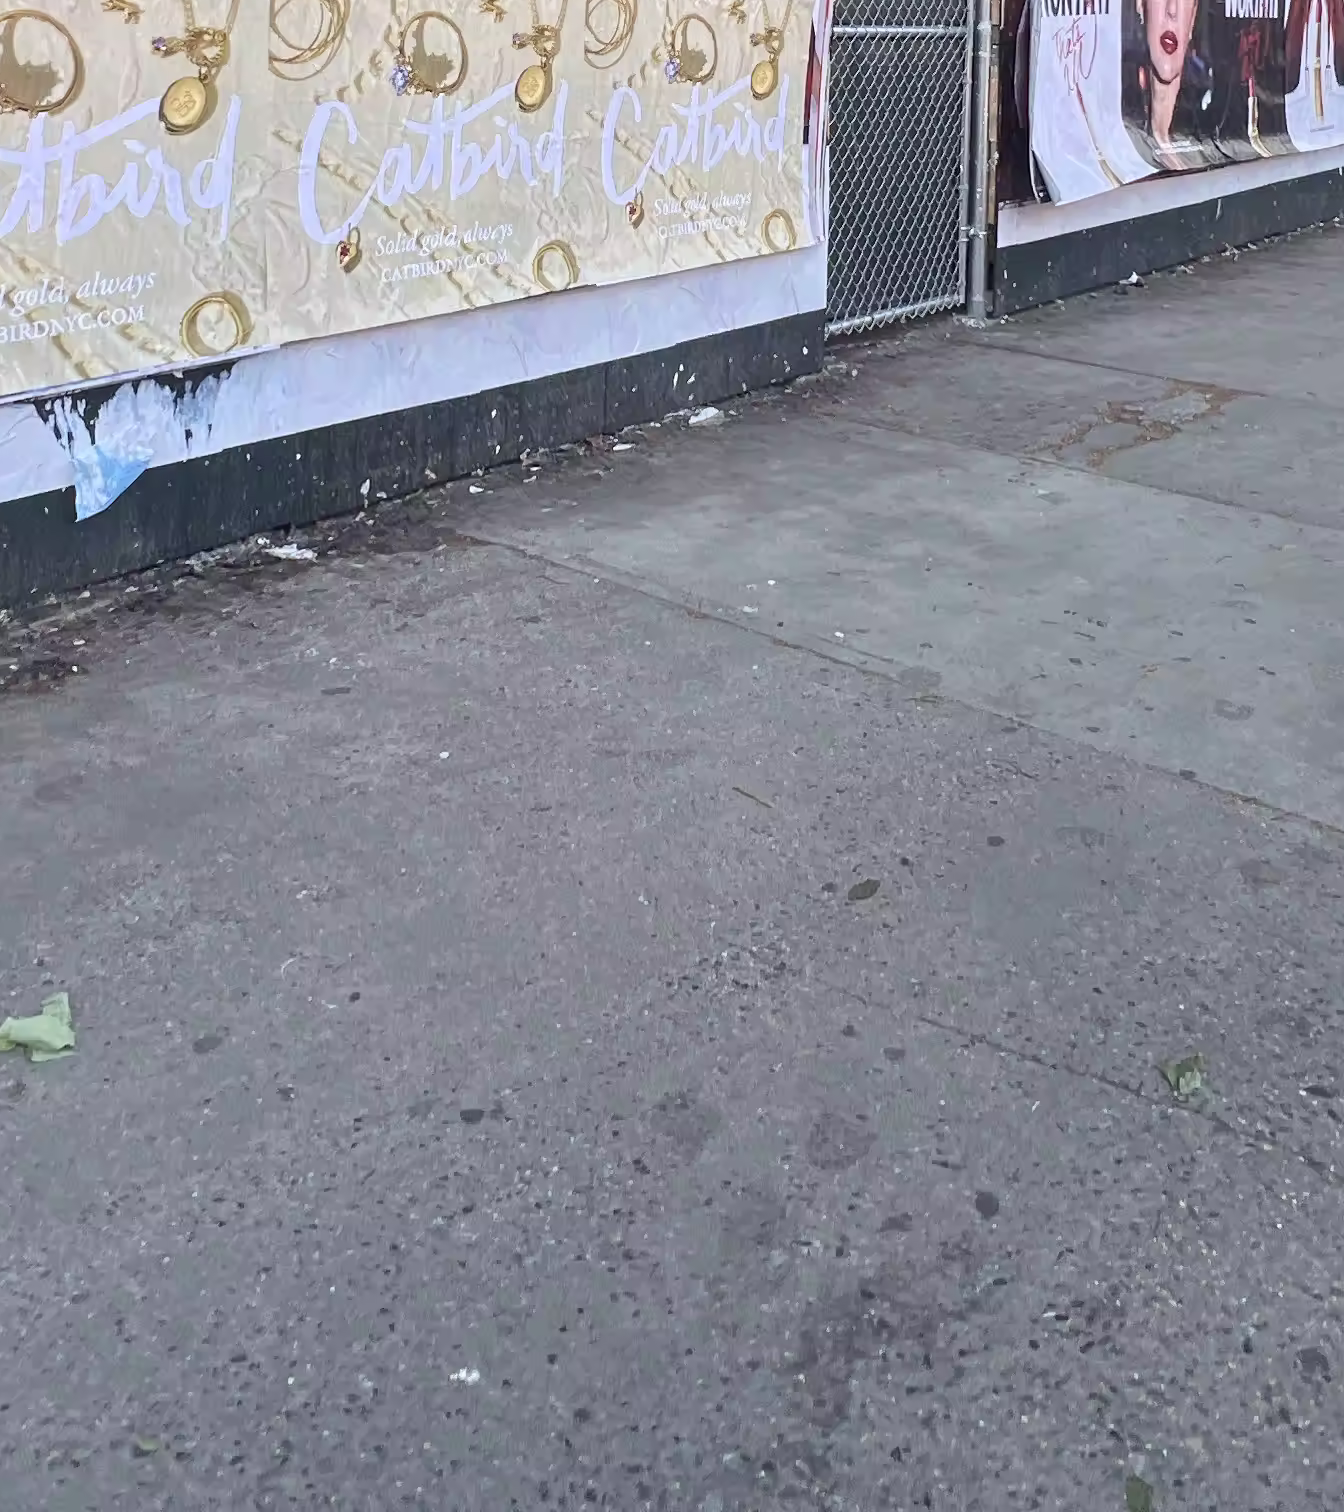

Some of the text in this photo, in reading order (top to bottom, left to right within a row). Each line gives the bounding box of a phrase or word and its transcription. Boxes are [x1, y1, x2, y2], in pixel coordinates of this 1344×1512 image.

[298, 78, 569, 245] Catbird
[600, 71, 790, 206] Catbird
[375, 228, 419, 257] Solid
[381, 249, 508, 283] CATBIRDNYC.COM
[9, 276, 70, 318] gold,
[75, 271, 157, 299] always
